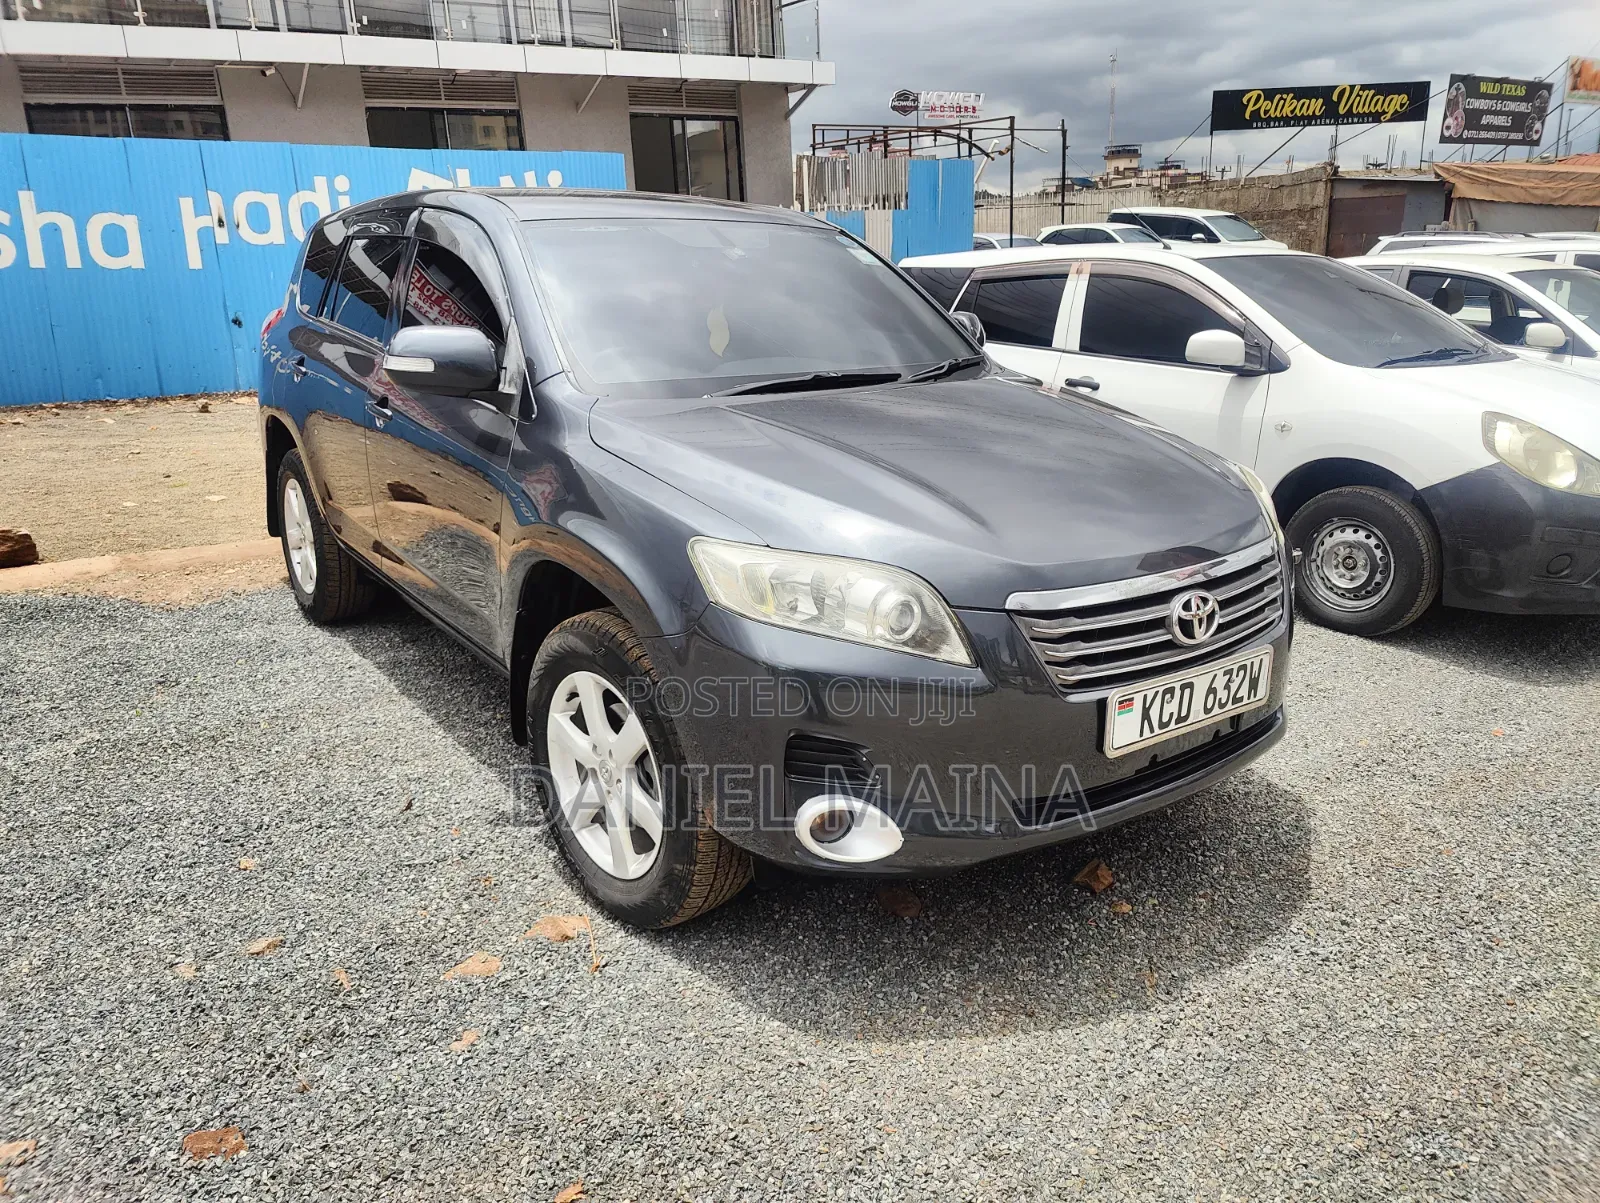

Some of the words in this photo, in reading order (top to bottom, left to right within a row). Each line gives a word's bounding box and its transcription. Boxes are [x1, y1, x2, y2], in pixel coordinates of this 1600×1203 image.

[1480, 82, 1500, 94] WILD
[1502, 84, 1526, 96] TEXAS
[930, 105, 977, 114] MOTORS
[1242, 90, 1326, 120] Pelikan
[1332, 84, 1410, 121] Village
[1466, 98, 1496, 110] COWBOYS
[1502, 101, 1533, 113] COWGIRLS
[1480, 115, 1512, 127] APPARELS
[1139, 681, 1194, 738] KCD
[1203, 657, 1263, 716] 632W
